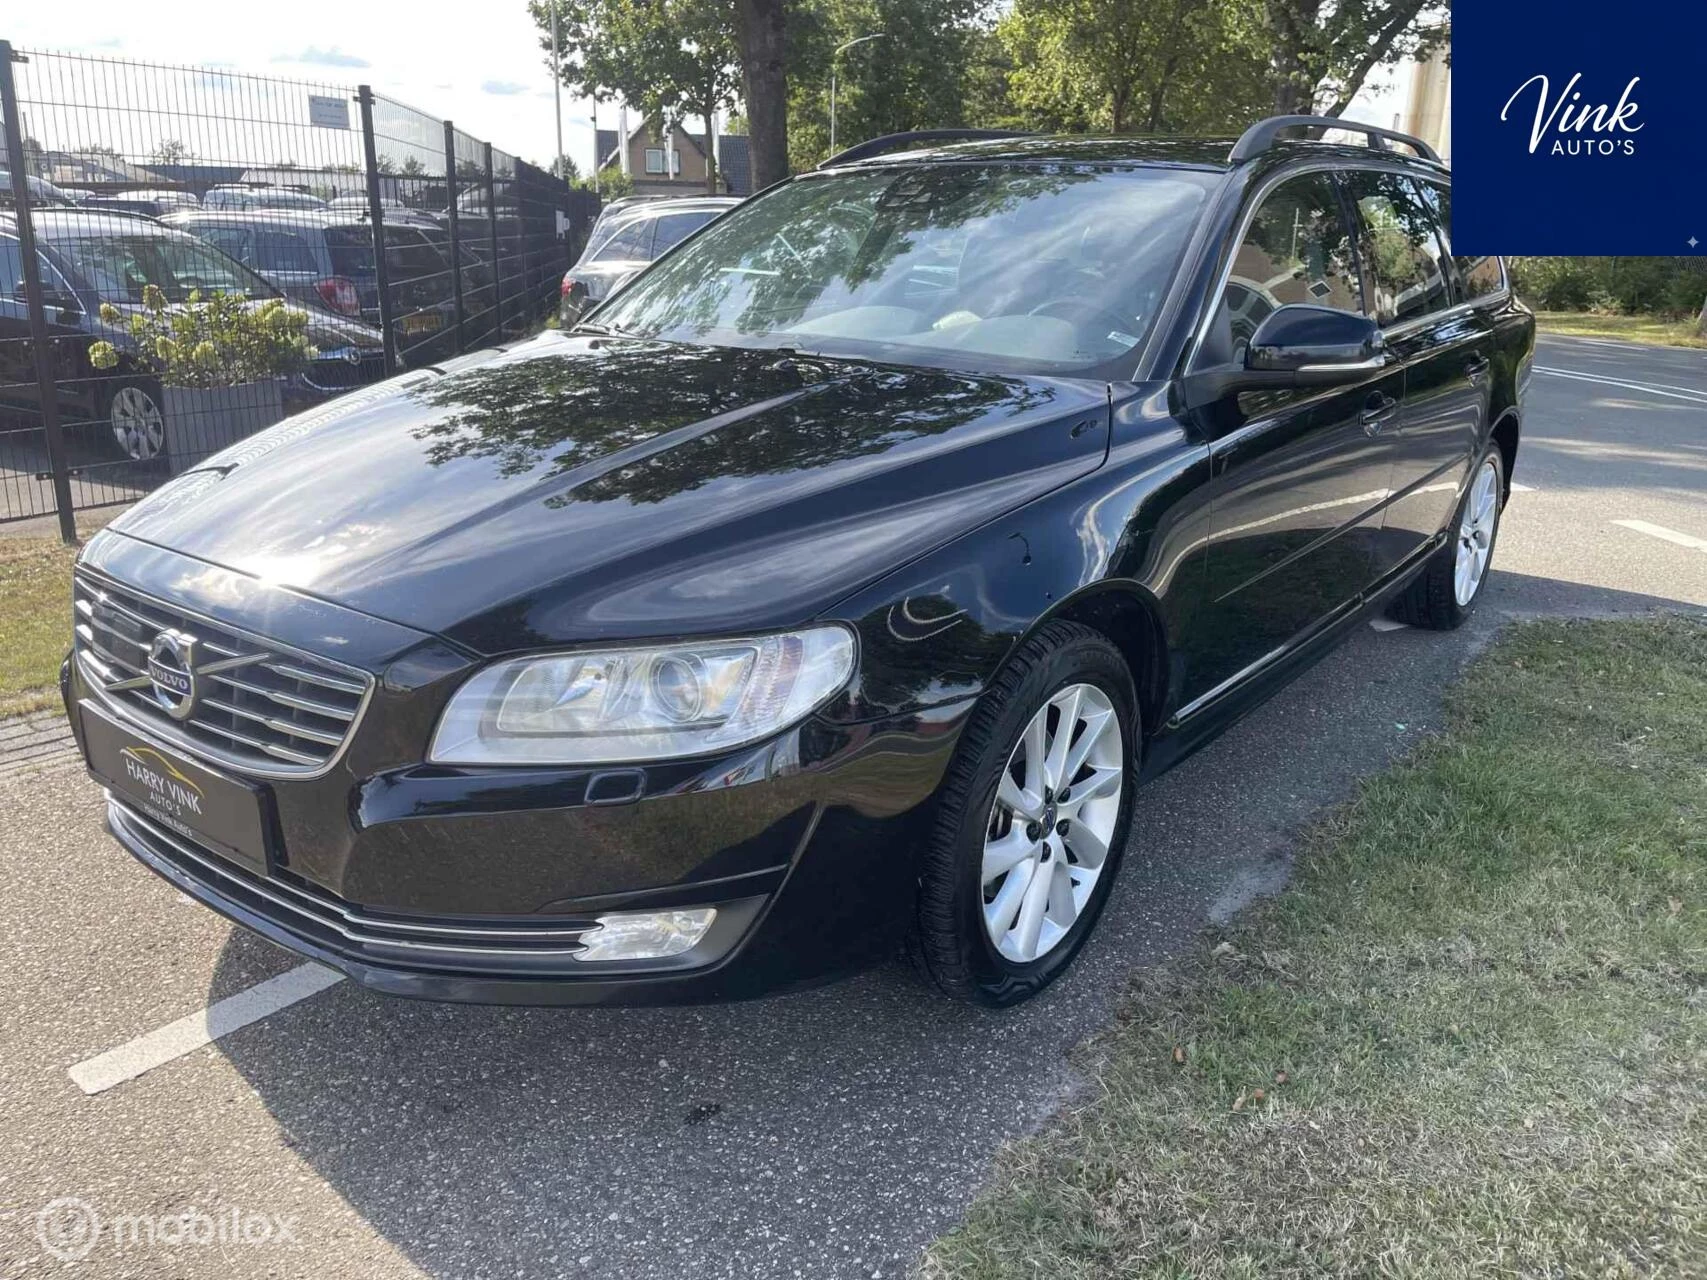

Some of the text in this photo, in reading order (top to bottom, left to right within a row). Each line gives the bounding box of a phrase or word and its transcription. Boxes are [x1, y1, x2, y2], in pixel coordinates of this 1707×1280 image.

[150, 665, 188, 690] VOLVO
[125, 758, 202, 815] HARRY VINK
